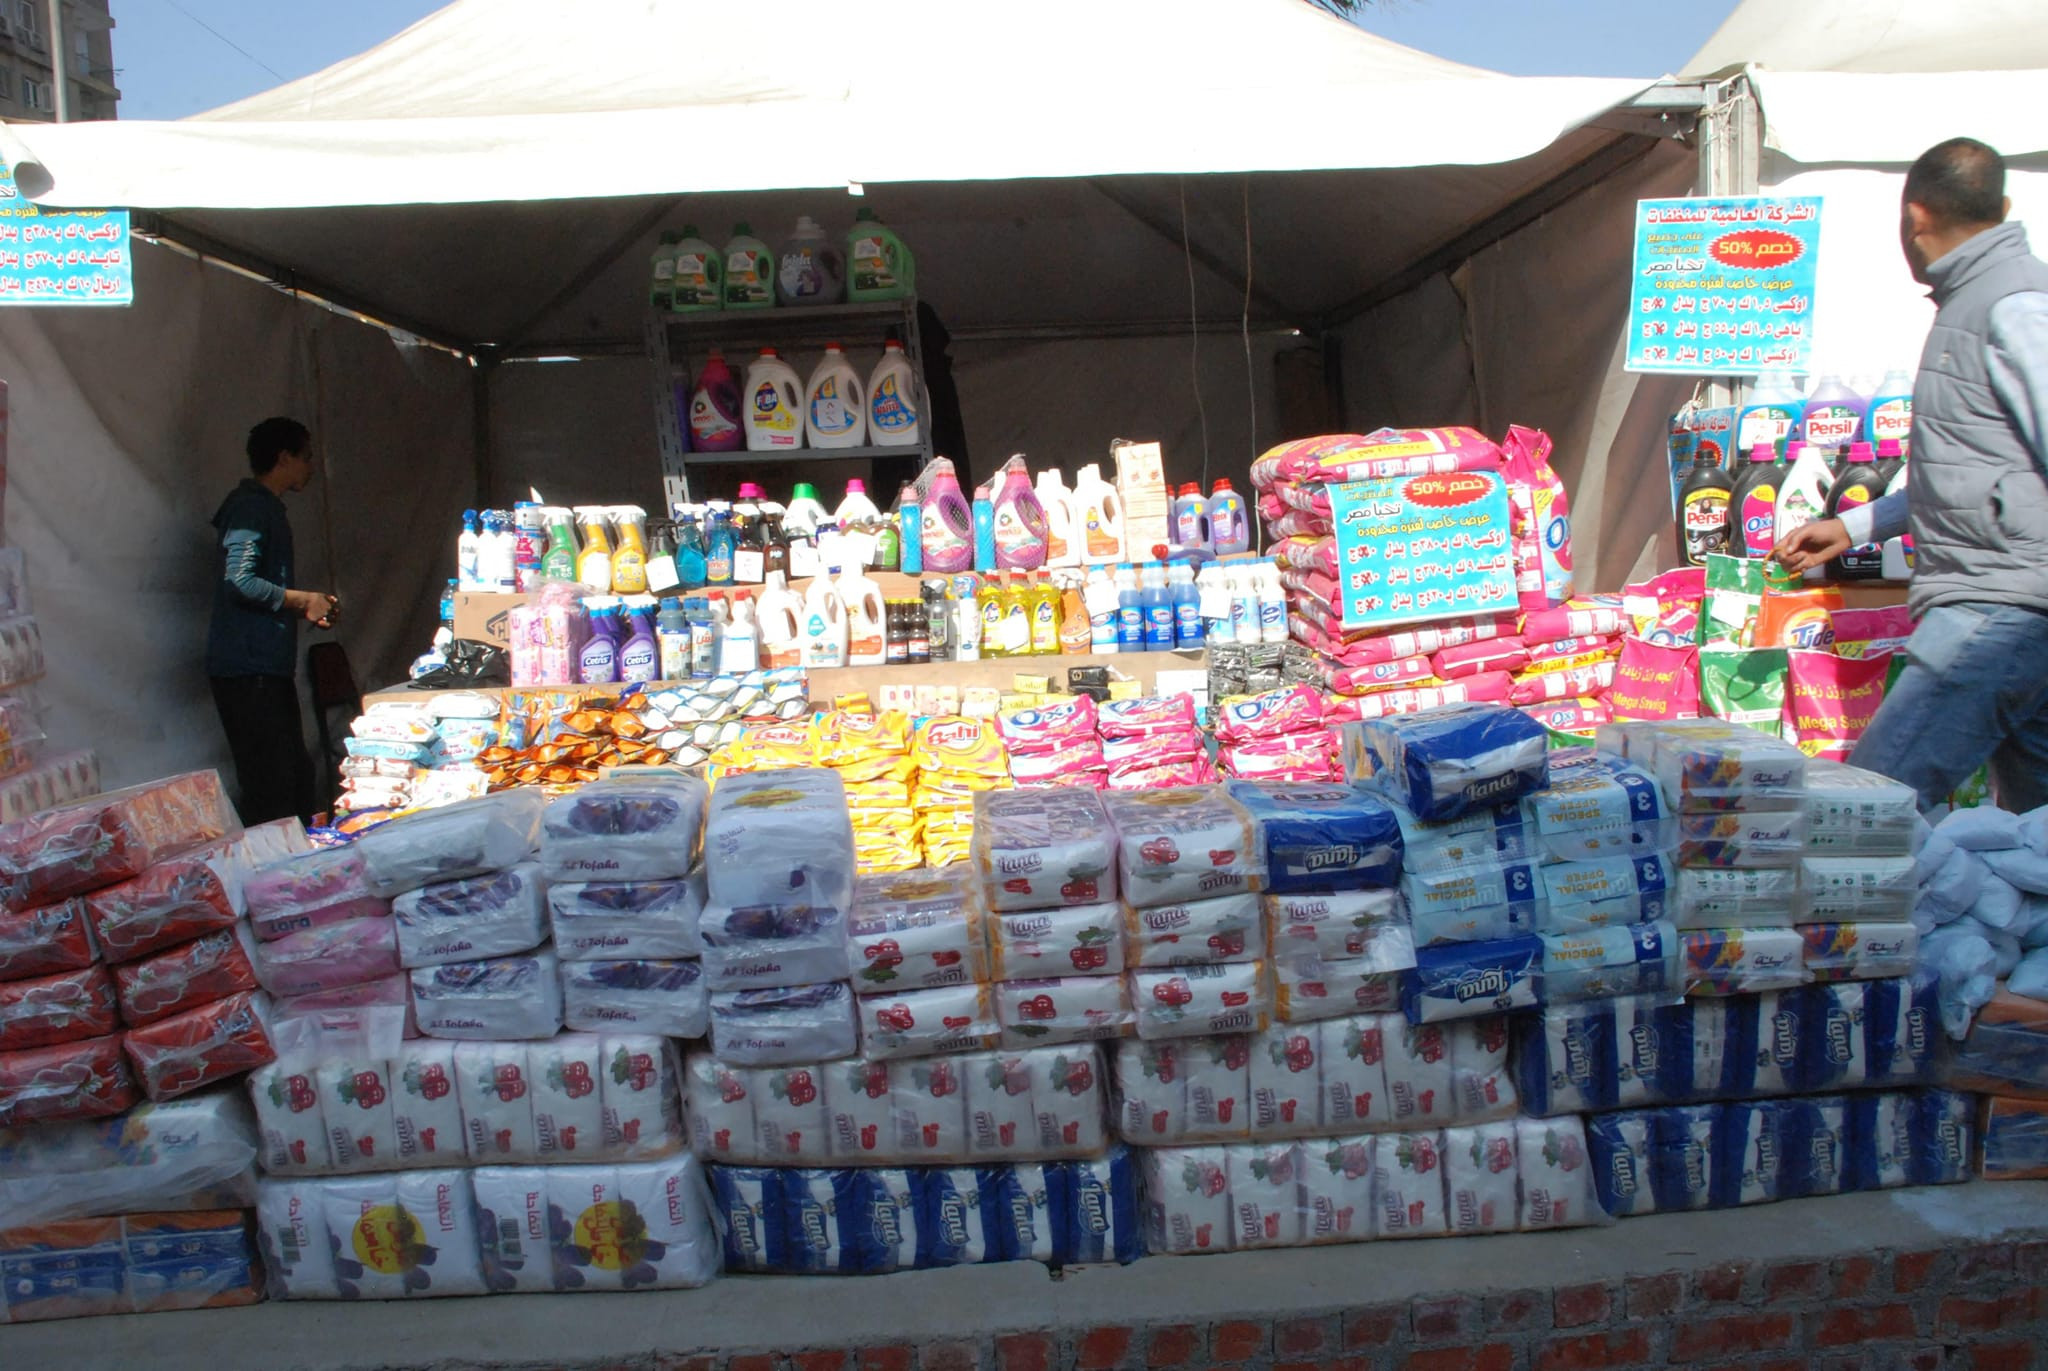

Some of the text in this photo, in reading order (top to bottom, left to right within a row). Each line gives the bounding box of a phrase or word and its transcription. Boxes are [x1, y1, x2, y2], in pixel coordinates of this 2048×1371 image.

[1647, 204, 1814, 226] الشركة العالمية للمنظفات
[1719, 241, 1793, 257] خصم 50%
[1645, 259, 1704, 274] تحيا مصر
[1673, 297, 1695, 312] بدل
[1675, 322, 1696, 337] بدل
[1676, 346, 1697, 362] بدل
[1809, 421, 1852, 435] Persil
[1876, 415, 1912, 430] Pers
[1412, 478, 1484, 495] خصم 50%
[1345, 503, 1400, 523] تحيا مصر
[1687, 512, 1727, 525] Persil
[1357, 511, 1490, 537] عرض خاص لفترة محدودة
[1385, 543, 1404, 558] بدل
[1389, 569, 1407, 584] بدل
[1392, 594, 1411, 609] بدل
[1791, 624, 1835, 648] Tide
[1798, 714, 1872, 731] Mega Savi
[1307, 844, 1360, 869] Lana
[1643, 862, 1658, 881] 3
[1512, 871, 1528, 892] 3
[1642, 930, 1656, 950] 3
[1461, 969, 1509, 1000] Lana
[1083, 1185, 1107, 1231] Lana
[731, 1207, 755, 1249] Lana
[803, 1206, 827, 1247] Lana
[875, 1199, 899, 1244] Lana
[943, 1198, 968, 1243] Lana
[1012, 1198, 1033, 1242] Lana
